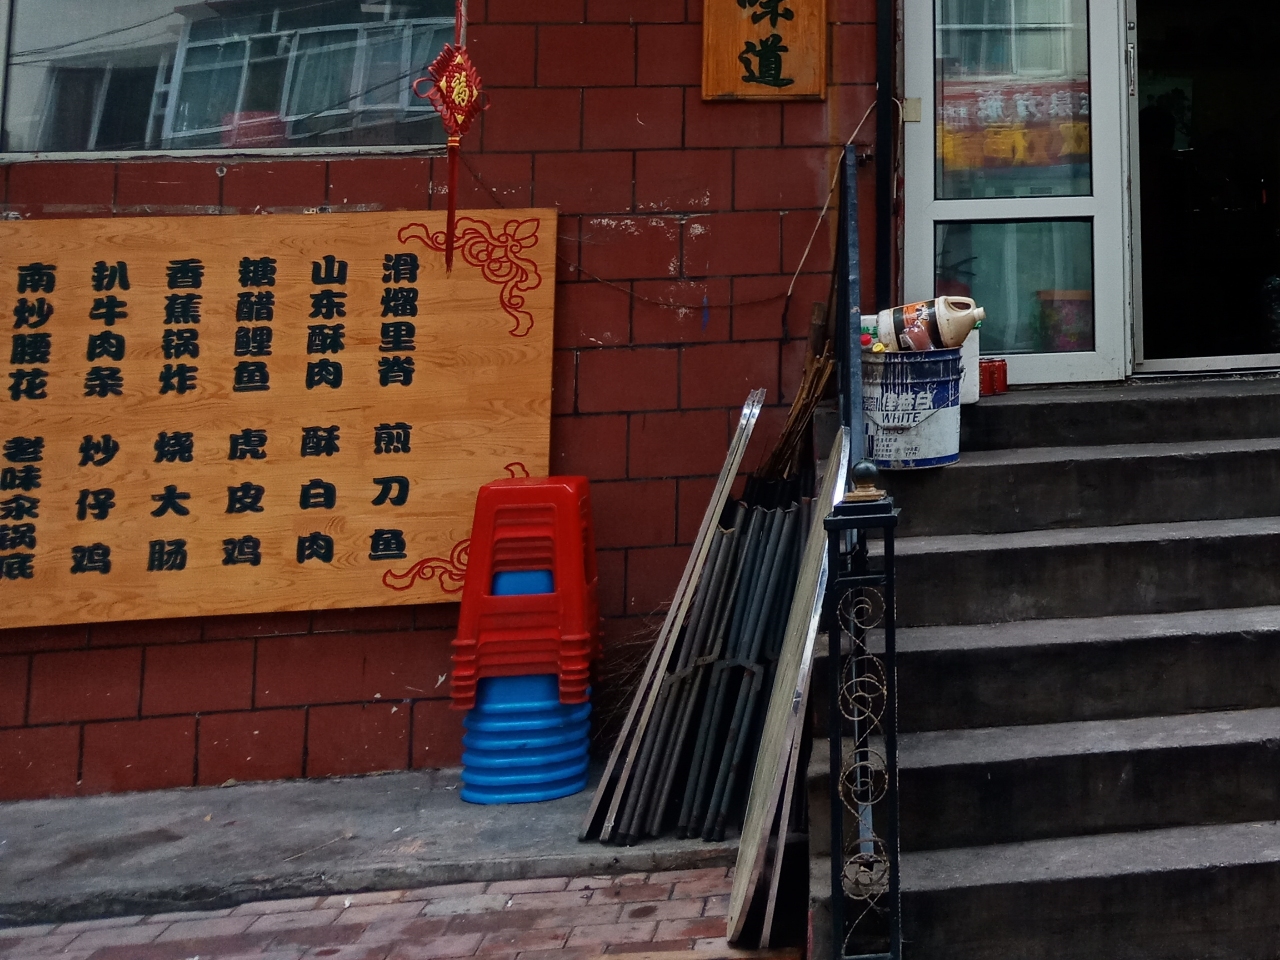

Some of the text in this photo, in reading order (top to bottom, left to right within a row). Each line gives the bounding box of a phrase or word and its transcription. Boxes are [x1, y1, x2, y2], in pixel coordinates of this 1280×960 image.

[8, 262, 57, 401] 南炒腰花
[84, 260, 130, 397] 扒牛肉条
[158, 258, 205, 394] 香蕉锅炸
[233, 256, 277, 392] 糖醋鲤鱼
[305, 254, 348, 390] 山东酥肉
[882, 413, 921, 423] WHITE
[70, 434, 120, 574] 炒仔鸡
[147, 431, 194, 572] 烧大肠
[222, 428, 267, 566] 虎皮鸡
[296, 425, 340, 564] 酥白肉
[368, 422, 412, 561] 煎刀鱼
